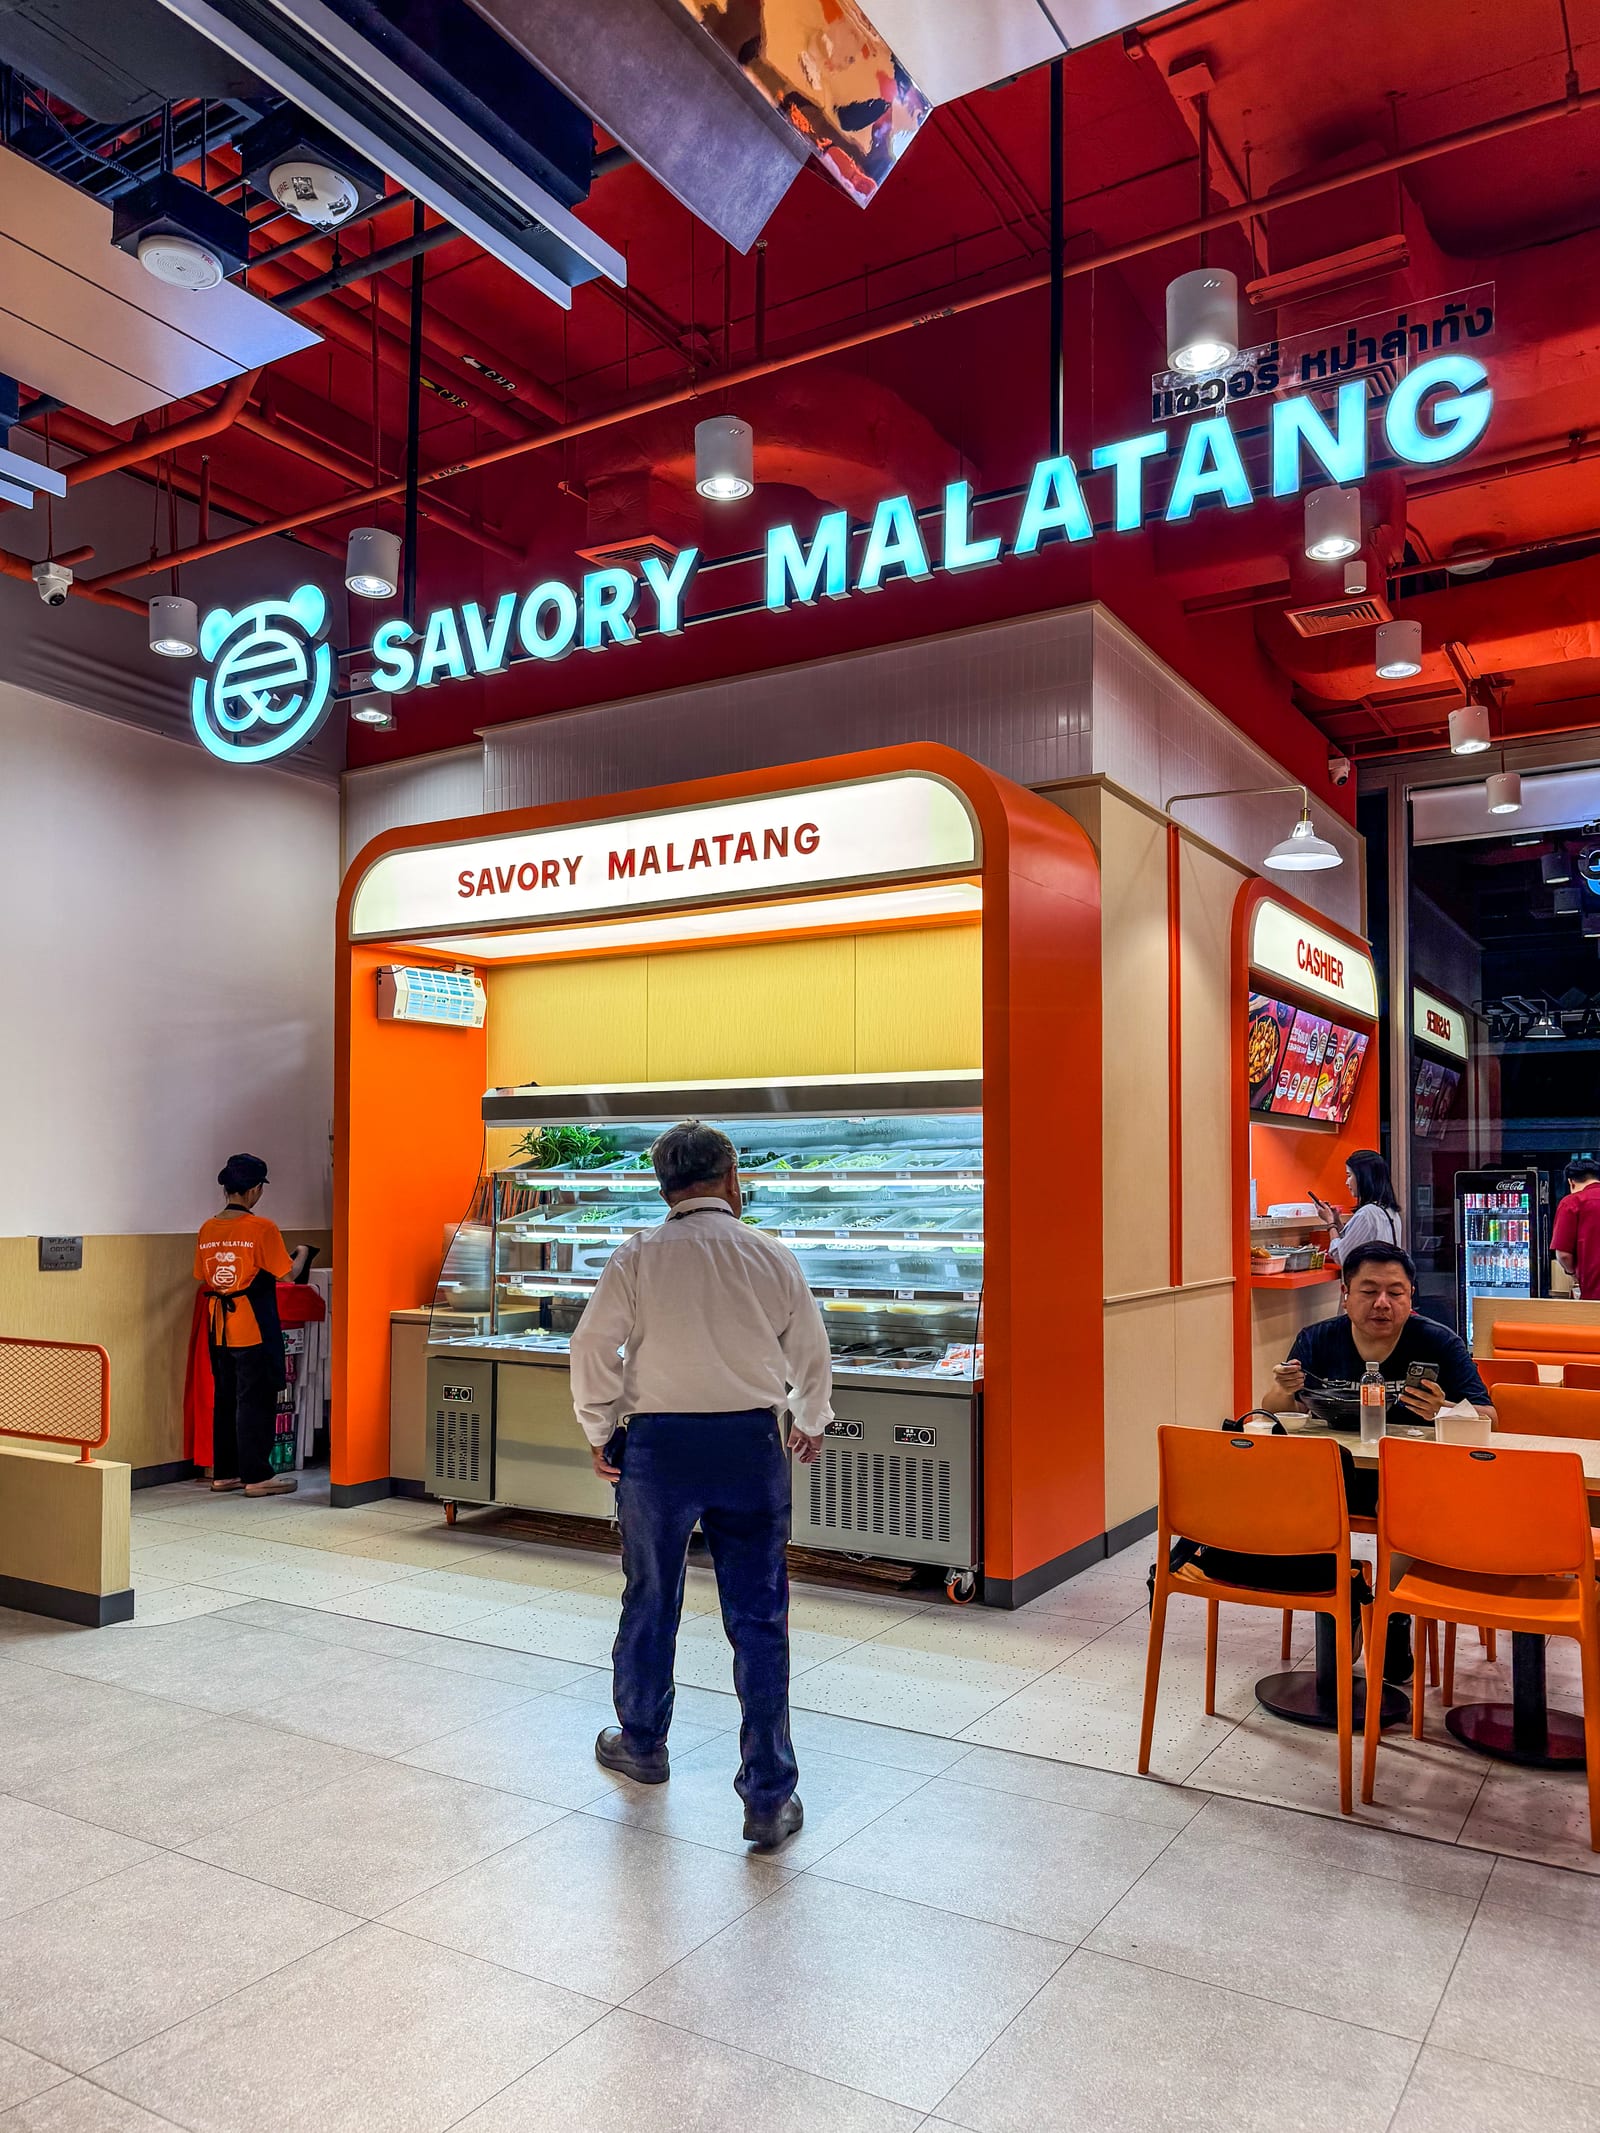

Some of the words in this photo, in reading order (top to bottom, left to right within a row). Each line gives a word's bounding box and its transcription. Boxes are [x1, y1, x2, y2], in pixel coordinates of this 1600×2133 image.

[438, 389, 469, 408] CHS
[485, 370, 517, 391] CHR
[371, 547, 699, 693] SAVORY
[766, 355, 1492, 611] MALATANG
[457, 855, 584, 899] SAVORY
[608, 822, 821, 881] MALATANG
[1297, 938, 1345, 989] CASHIER
